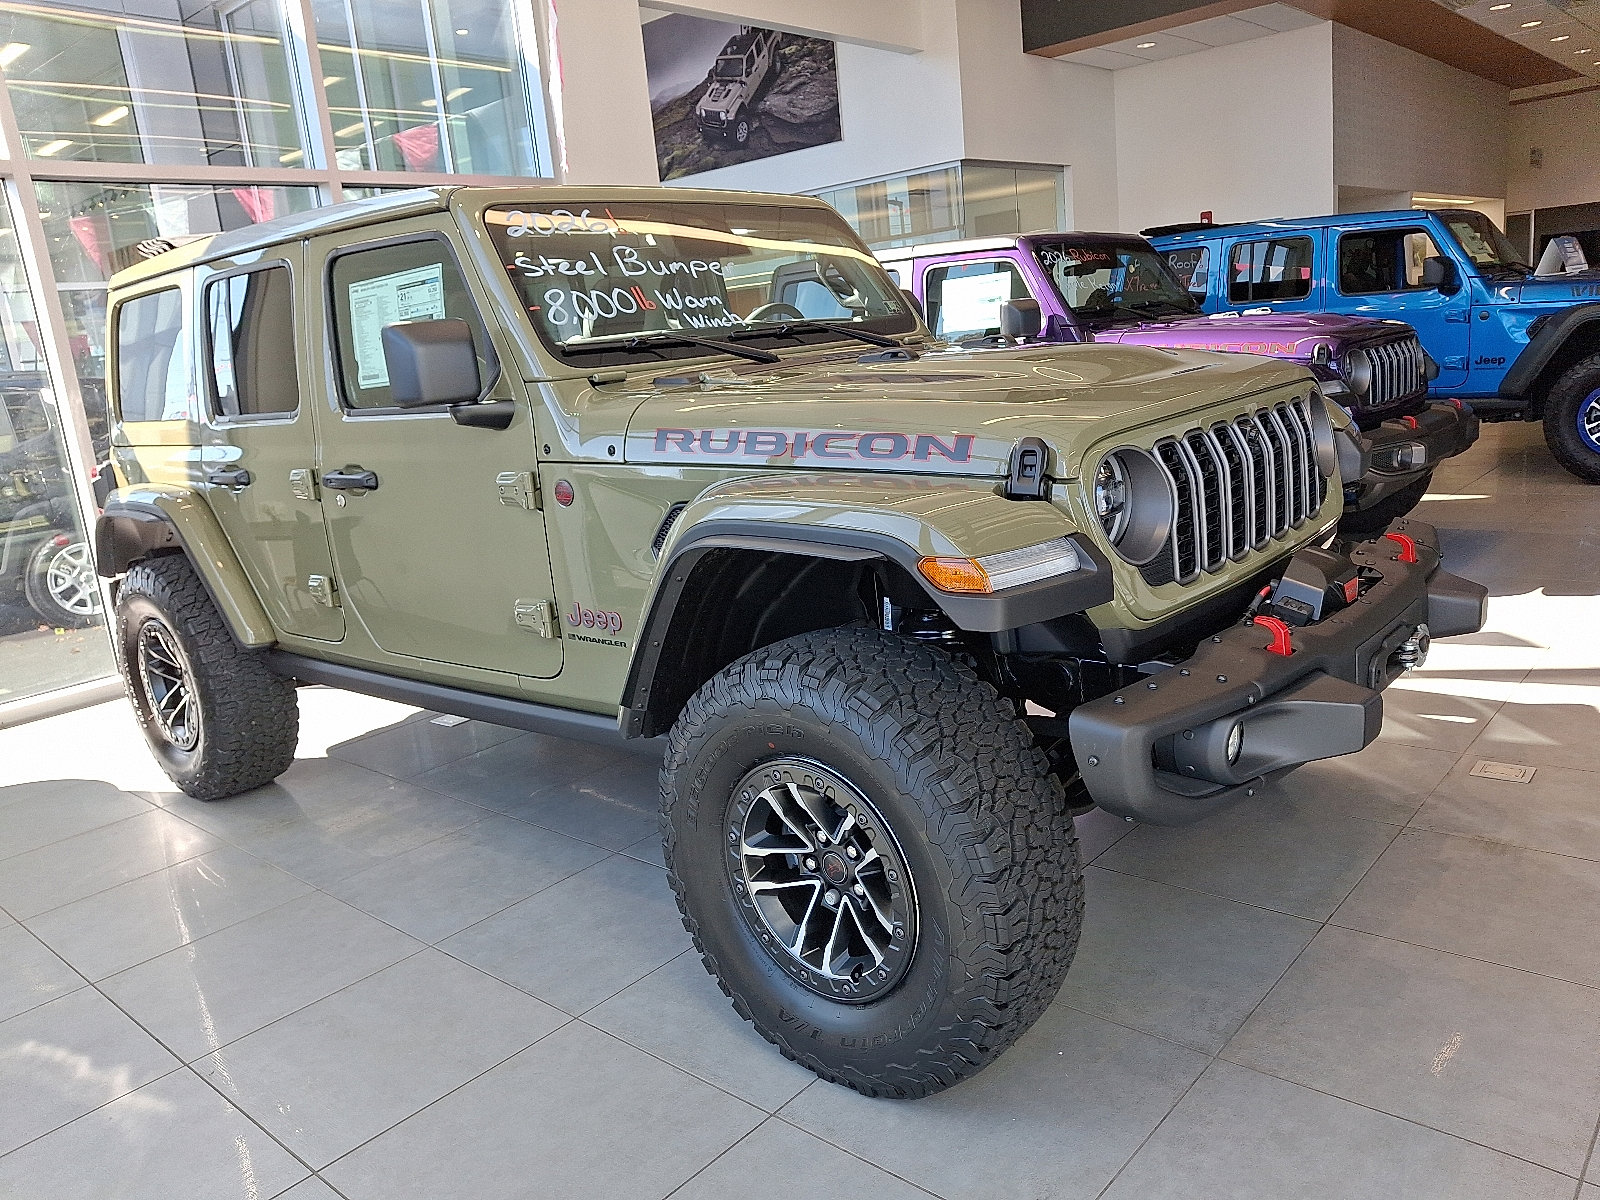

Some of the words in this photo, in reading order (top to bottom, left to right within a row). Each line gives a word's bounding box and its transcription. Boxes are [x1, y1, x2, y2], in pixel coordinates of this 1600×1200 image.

[613, 246, 735, 279] Bumper
[1069, 247, 1111, 263] Rubicon
[654, 287, 722, 310] Warn
[683, 307, 746, 329] Winch
[1474, 355, 1506, 366] Jeep
[654, 427, 976, 463] RUBICON
[566, 602, 622, 636] Jeep
[576, 634, 627, 648] WRANGLER
